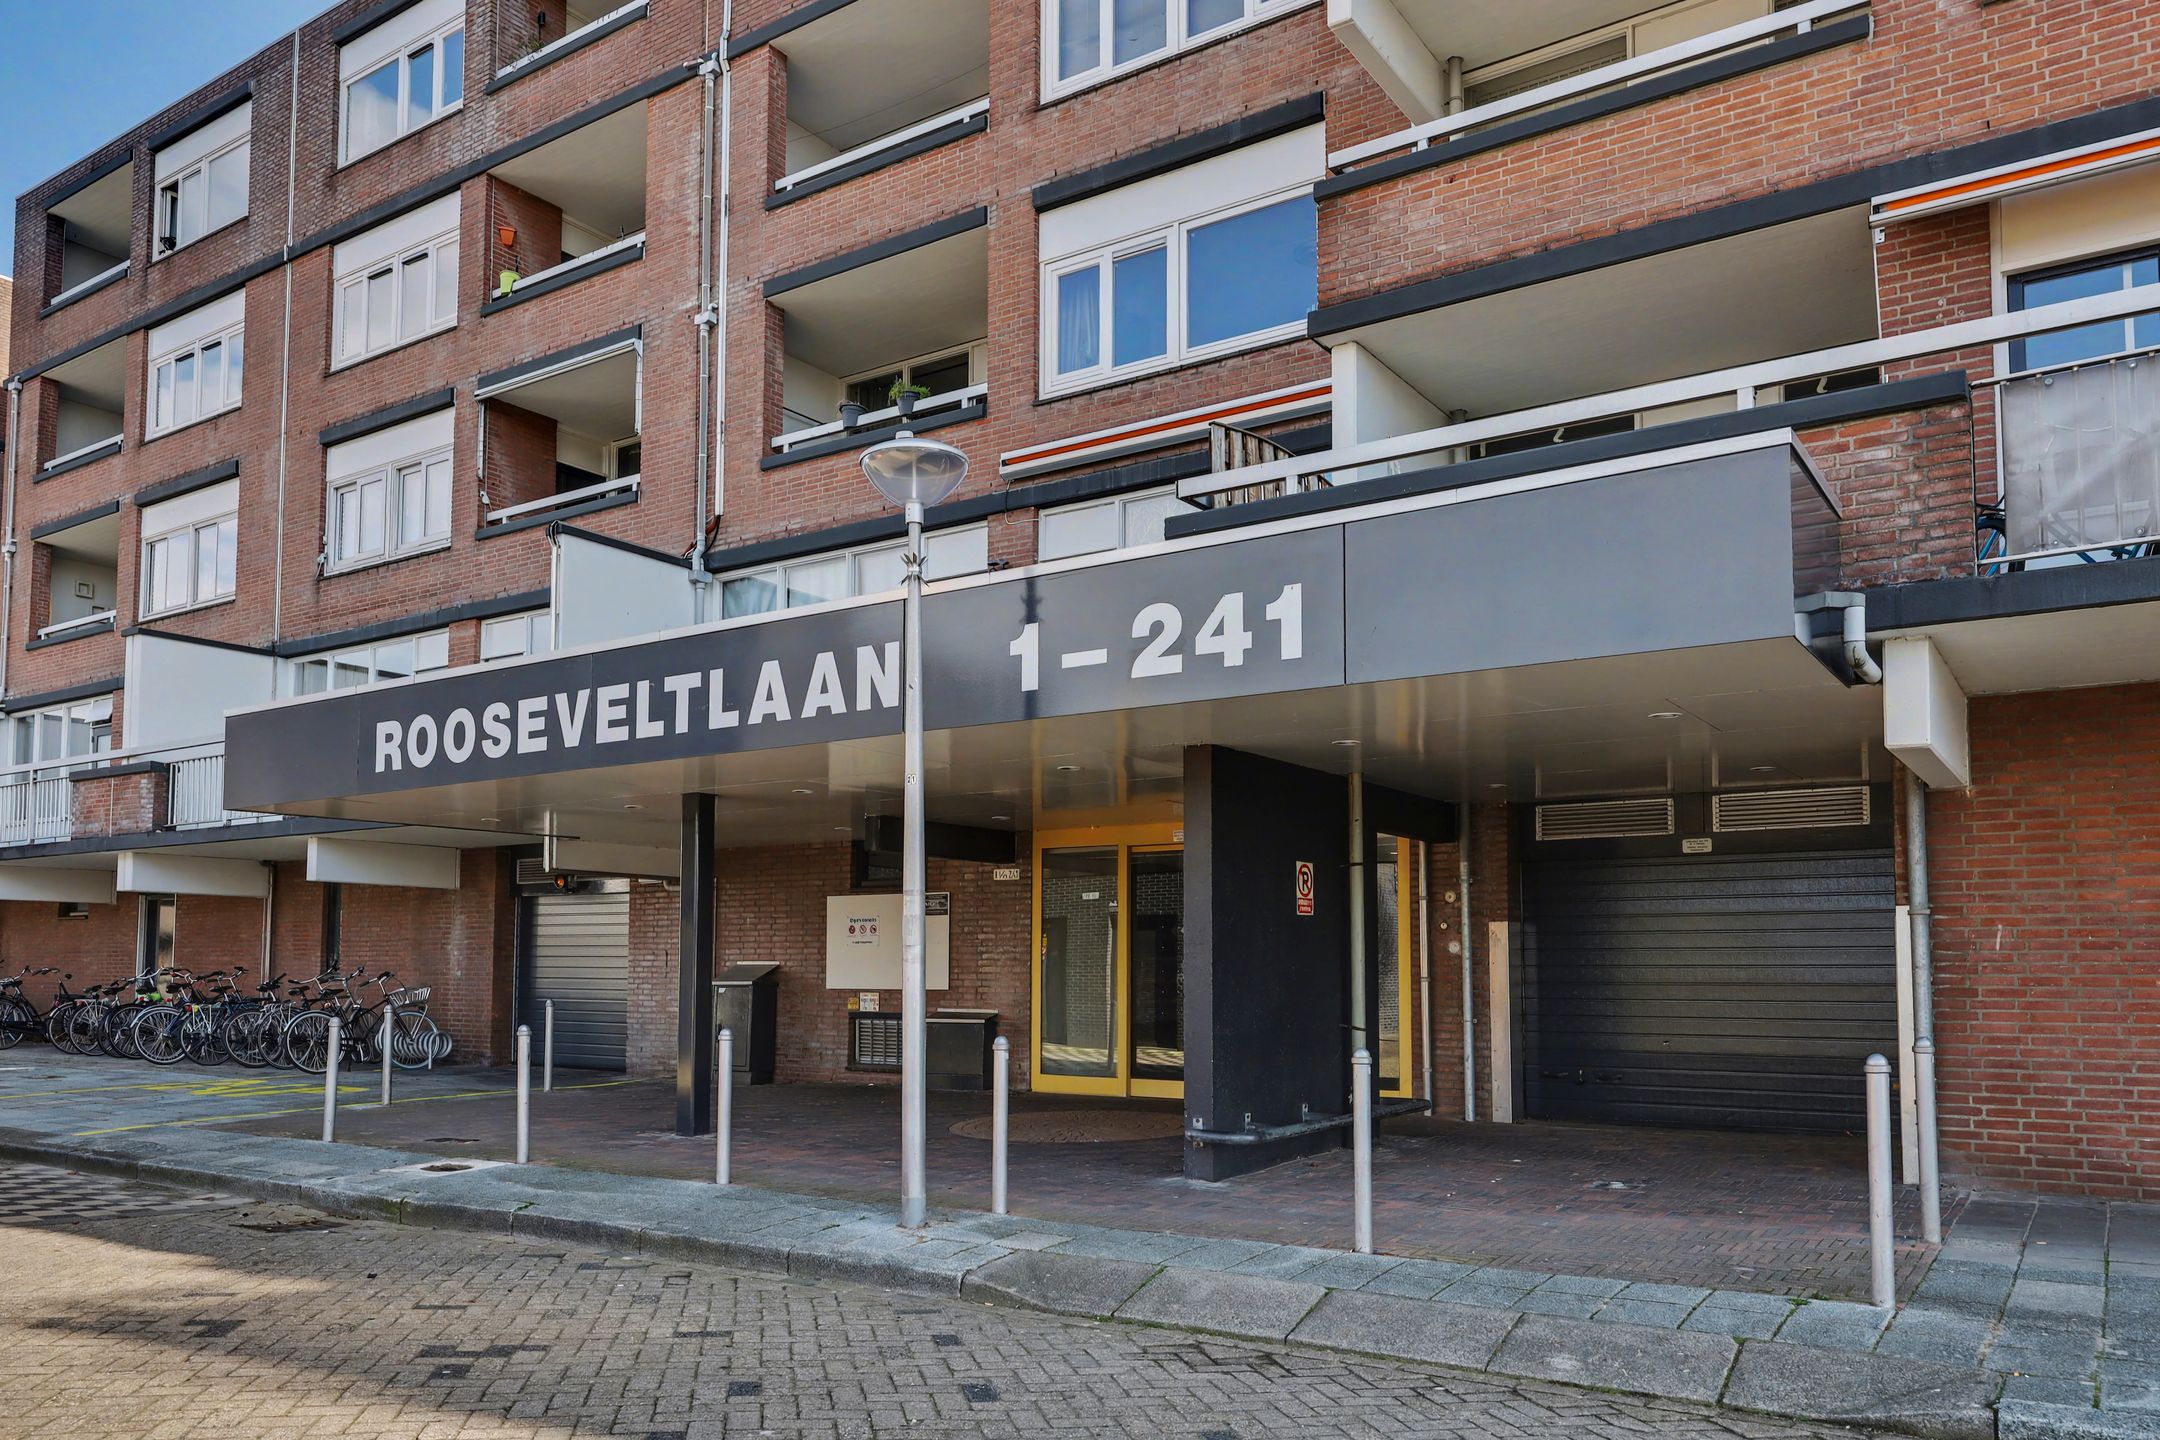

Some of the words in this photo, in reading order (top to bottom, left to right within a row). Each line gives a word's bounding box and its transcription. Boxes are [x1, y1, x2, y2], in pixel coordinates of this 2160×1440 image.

[375, 641, 900, 773] ROOSEVELTLAAN
[1009, 622, 1039, 692] 1
[1131, 583, 1302, 679] 241
